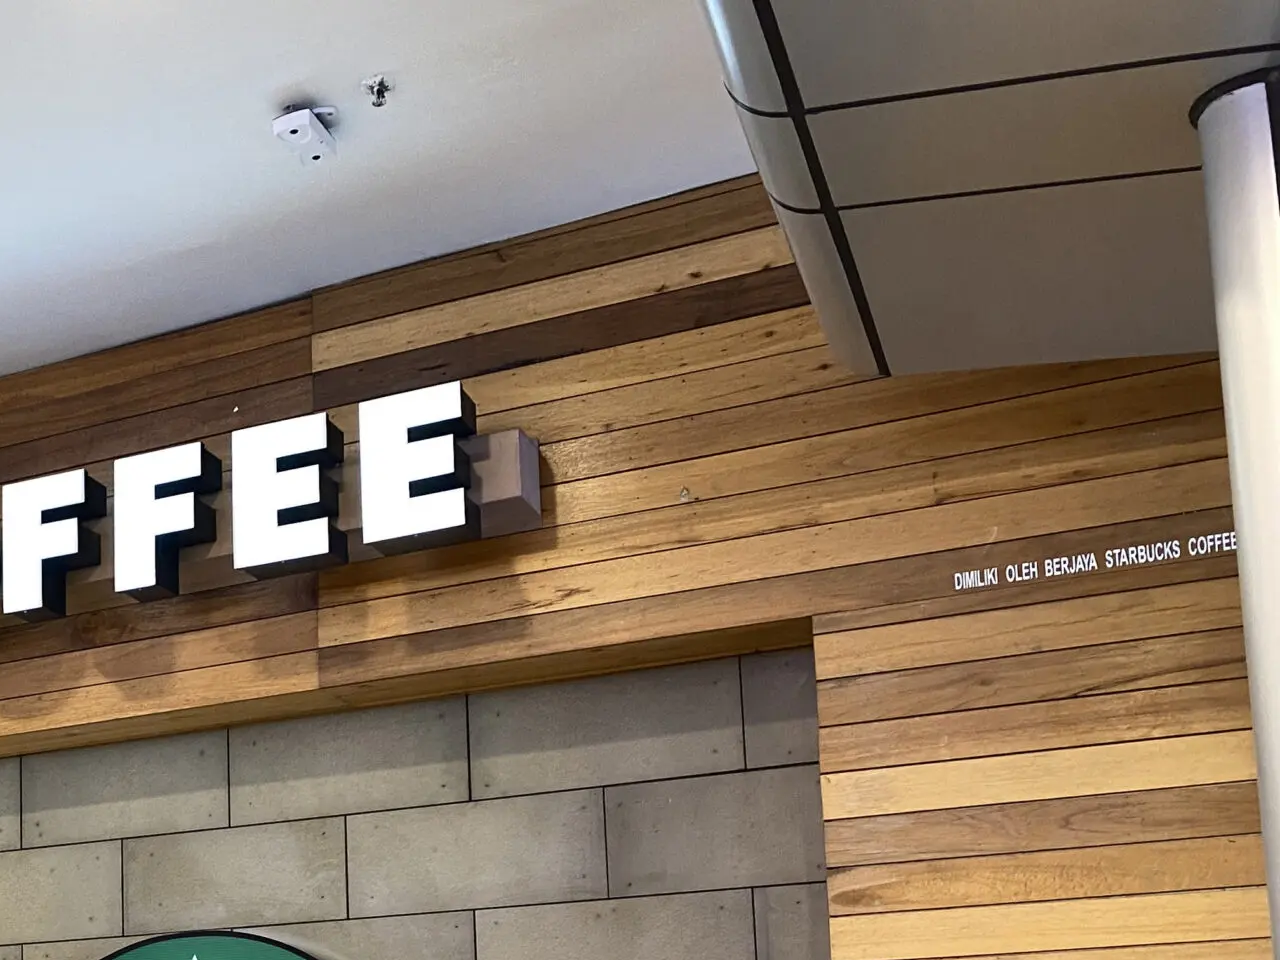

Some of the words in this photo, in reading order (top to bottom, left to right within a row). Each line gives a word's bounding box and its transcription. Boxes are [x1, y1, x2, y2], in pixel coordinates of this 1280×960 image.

[954, 567, 999, 590] DIMILIKI
[1005, 561, 1038, 583] OLEH
[1044, 552, 1098, 577] BERJAYA
[1105, 540, 1181, 568] STARBUCKS
[1188, 531, 1237, 556] COFFEE
